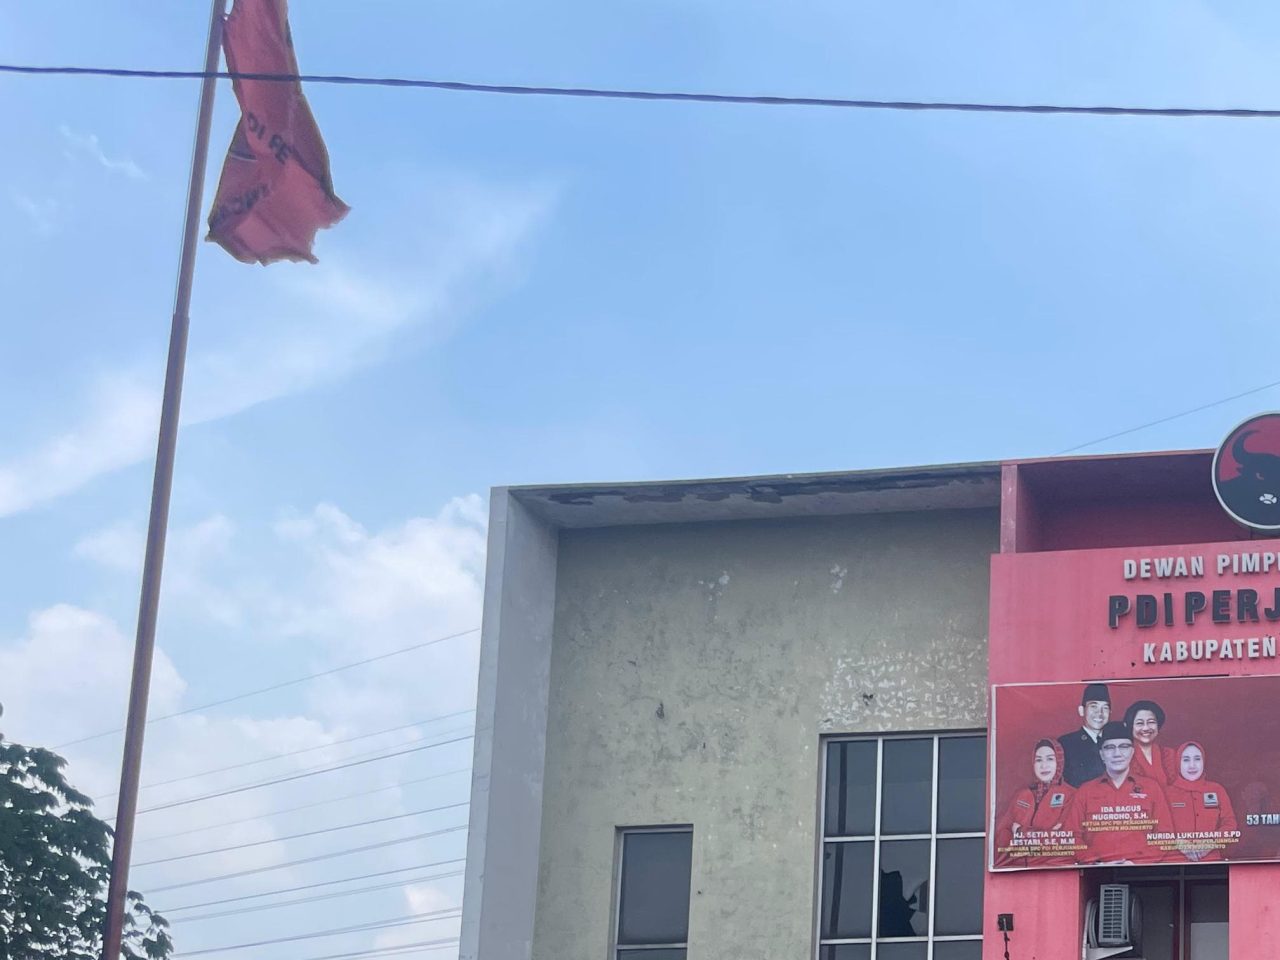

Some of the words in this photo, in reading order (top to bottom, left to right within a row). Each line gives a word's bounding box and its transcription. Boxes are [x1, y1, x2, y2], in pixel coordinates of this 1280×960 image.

[1123, 556, 1204, 580] DEWAN
[1108, 592, 1174, 629] PDI
[1143, 636, 1277, 664] KABUPATEN
[1115, 804, 1141, 812] BAGUS
[1246, 814, 1260, 826] 53
